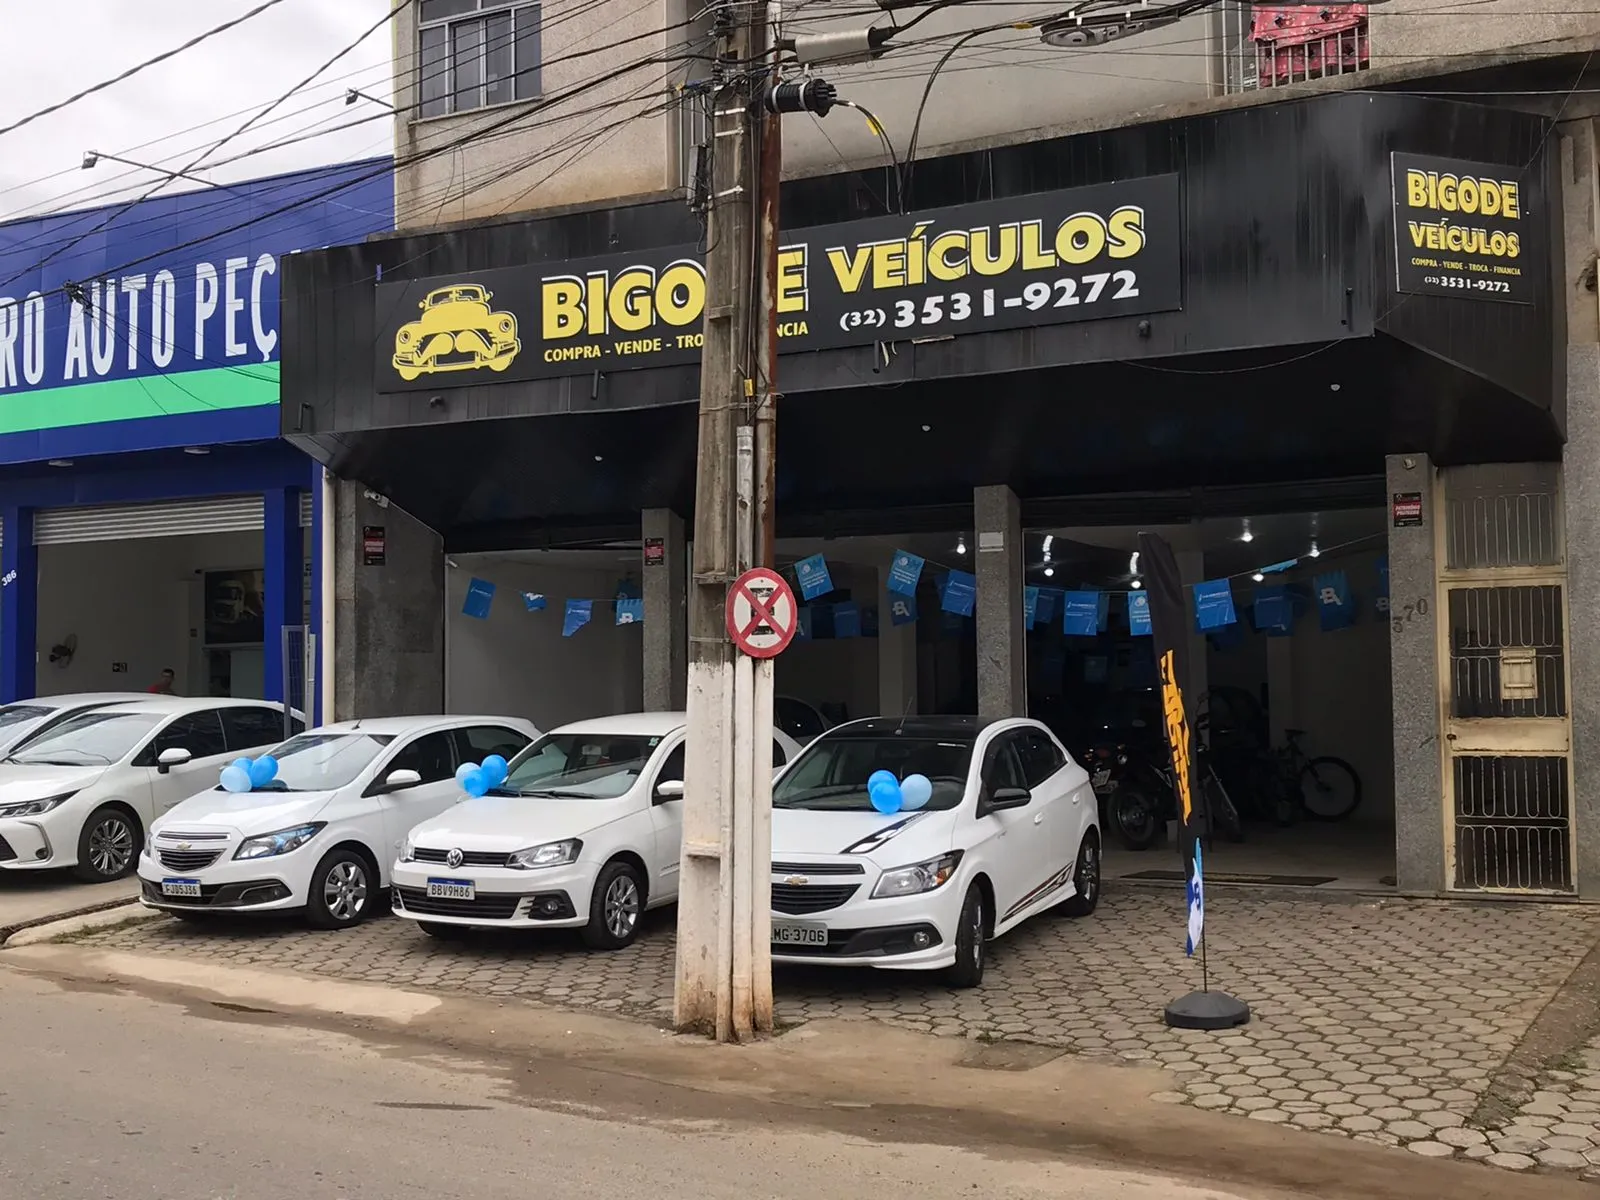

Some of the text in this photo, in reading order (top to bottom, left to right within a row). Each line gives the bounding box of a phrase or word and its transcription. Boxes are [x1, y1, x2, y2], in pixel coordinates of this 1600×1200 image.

[1407, 168, 1520, 220] BIGODE
[1408, 217, 1520, 258] VEÍCULOS
[541, 204, 1146, 340] BIGOE VEÍCULOS
[1411, 257, 1437, 268] COMPRA
[1442, 260, 1463, 270] VENDE
[1468, 263, 1489, 273] TROCA
[1493, 265, 1521, 276] FINANCIA
[1440, 275, 1510, 293] 3531-9272
[63, 269, 175, 380] AUTO
[195, 253, 277, 362] PEÇ
[839, 269, 1140, 332] (32) 3531-9272
[544, 344, 602, 363] COMPRA
[614, 337, 662, 355] VENDE
[675, 333, 704, 349] TRO
[776, 321, 809, 338] NCIA
[1, 569, 17, 587] 386
[431, 884, 470, 898] BBV9H86
[771, 928, 825, 943] MG-3706
